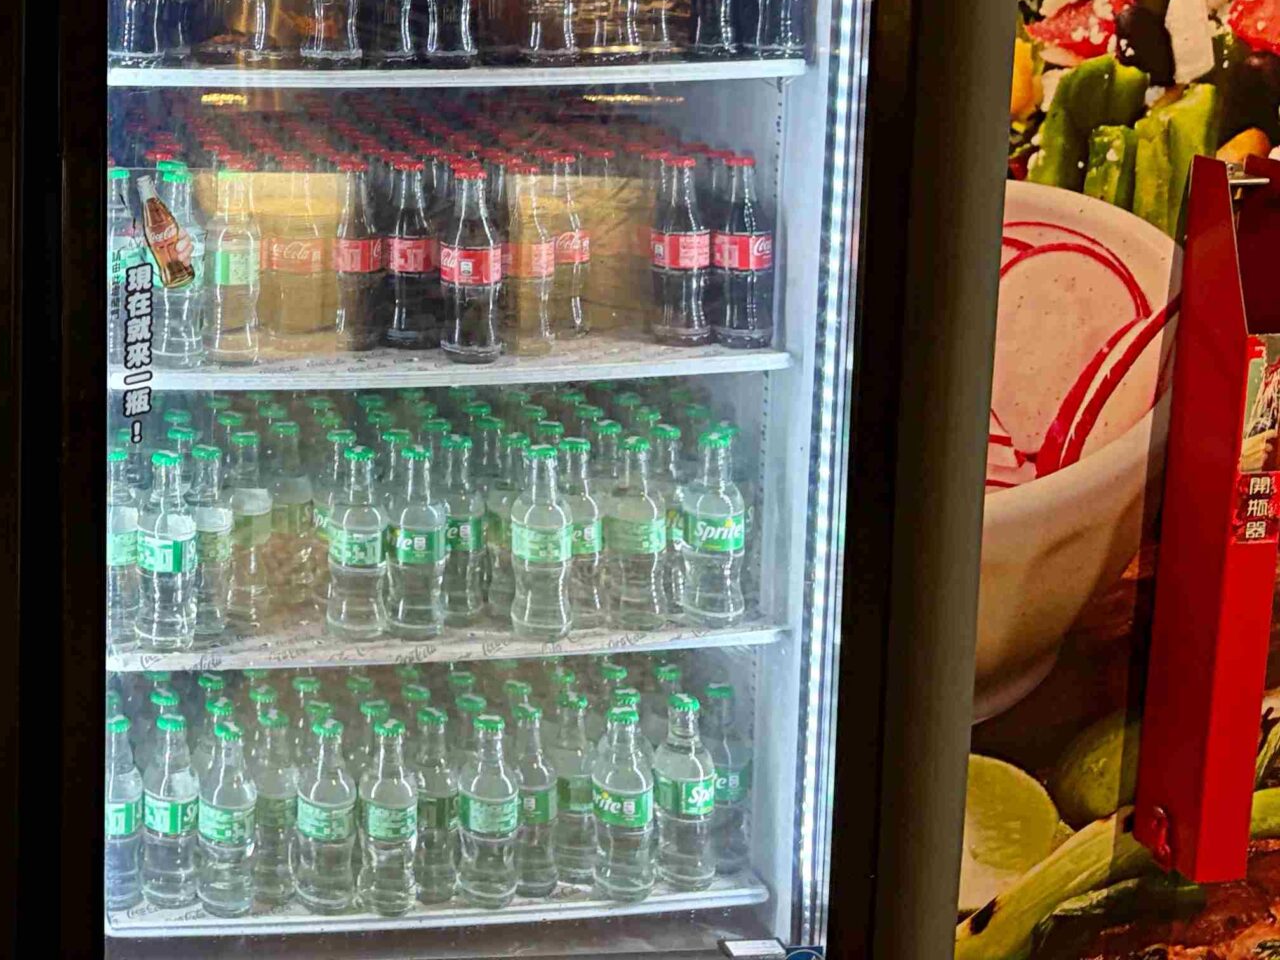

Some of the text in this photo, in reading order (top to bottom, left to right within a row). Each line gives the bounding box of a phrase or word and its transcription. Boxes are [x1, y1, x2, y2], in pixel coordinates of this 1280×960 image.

[124, 262, 154, 443] 現在就來一瓶!
[695, 520, 745, 542] Sprite
[1245, 476, 1271, 539] 開瓶器
